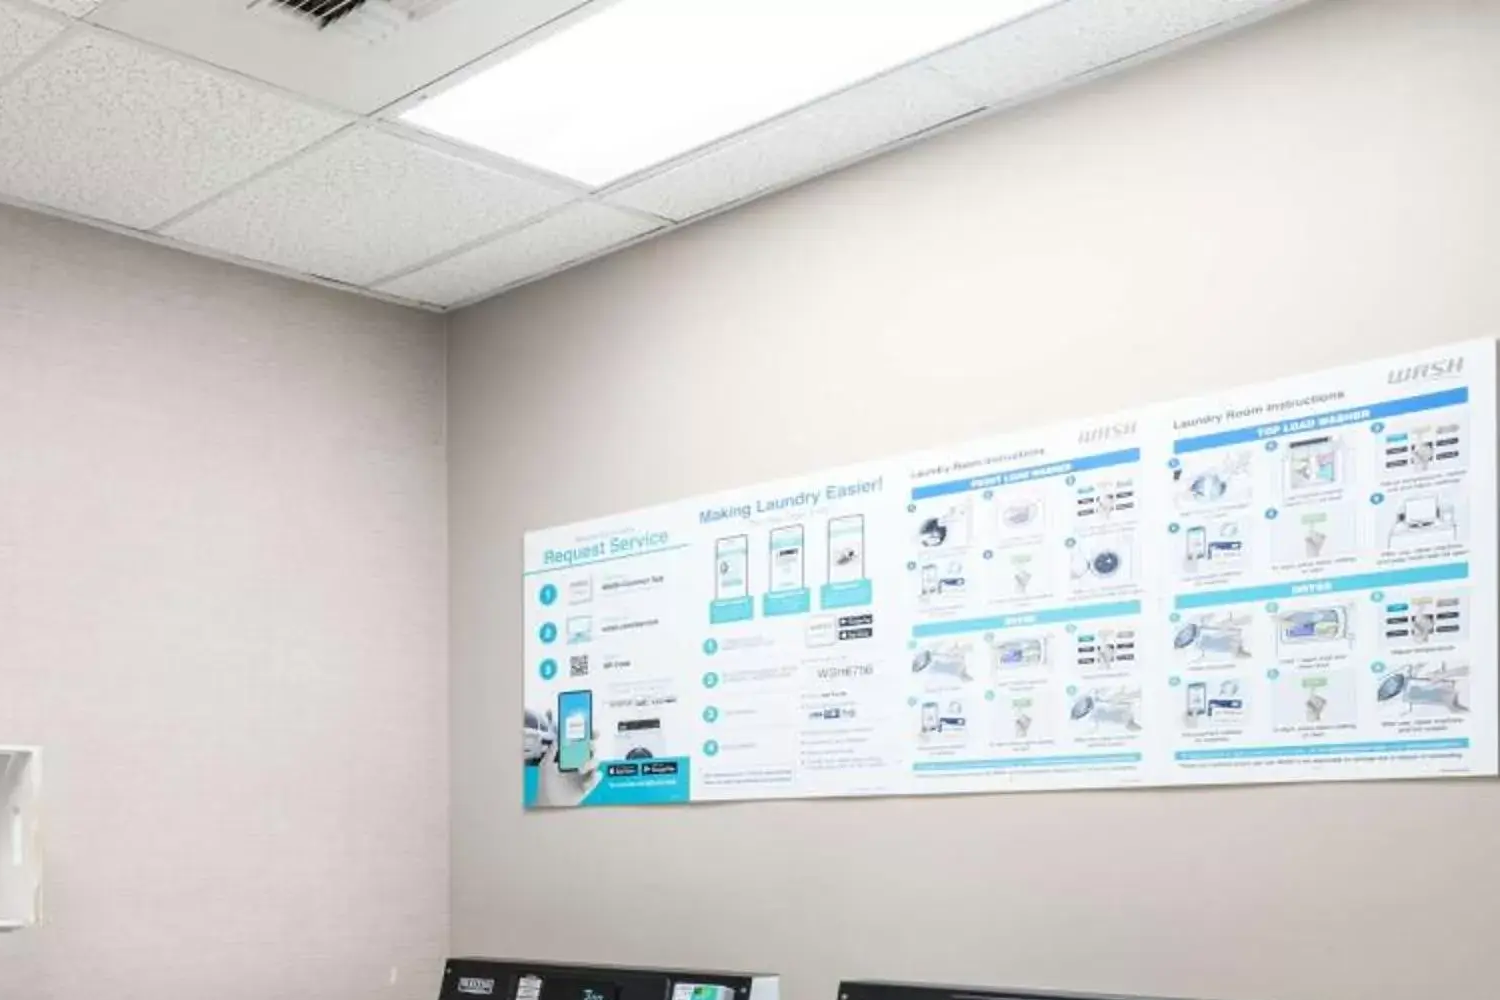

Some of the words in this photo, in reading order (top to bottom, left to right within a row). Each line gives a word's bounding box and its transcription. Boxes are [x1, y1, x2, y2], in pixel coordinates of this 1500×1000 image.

[1173, 414, 1222, 430] Laundry
[1225, 404, 1264, 419] Room
[1265, 391, 1345, 412] Instructions
[699, 502, 752, 524] Making
[755, 490, 822, 513] Laundry
[825, 475, 883, 500] Easier!
[543, 541, 605, 565] Request
[609, 530, 668, 553] Service
